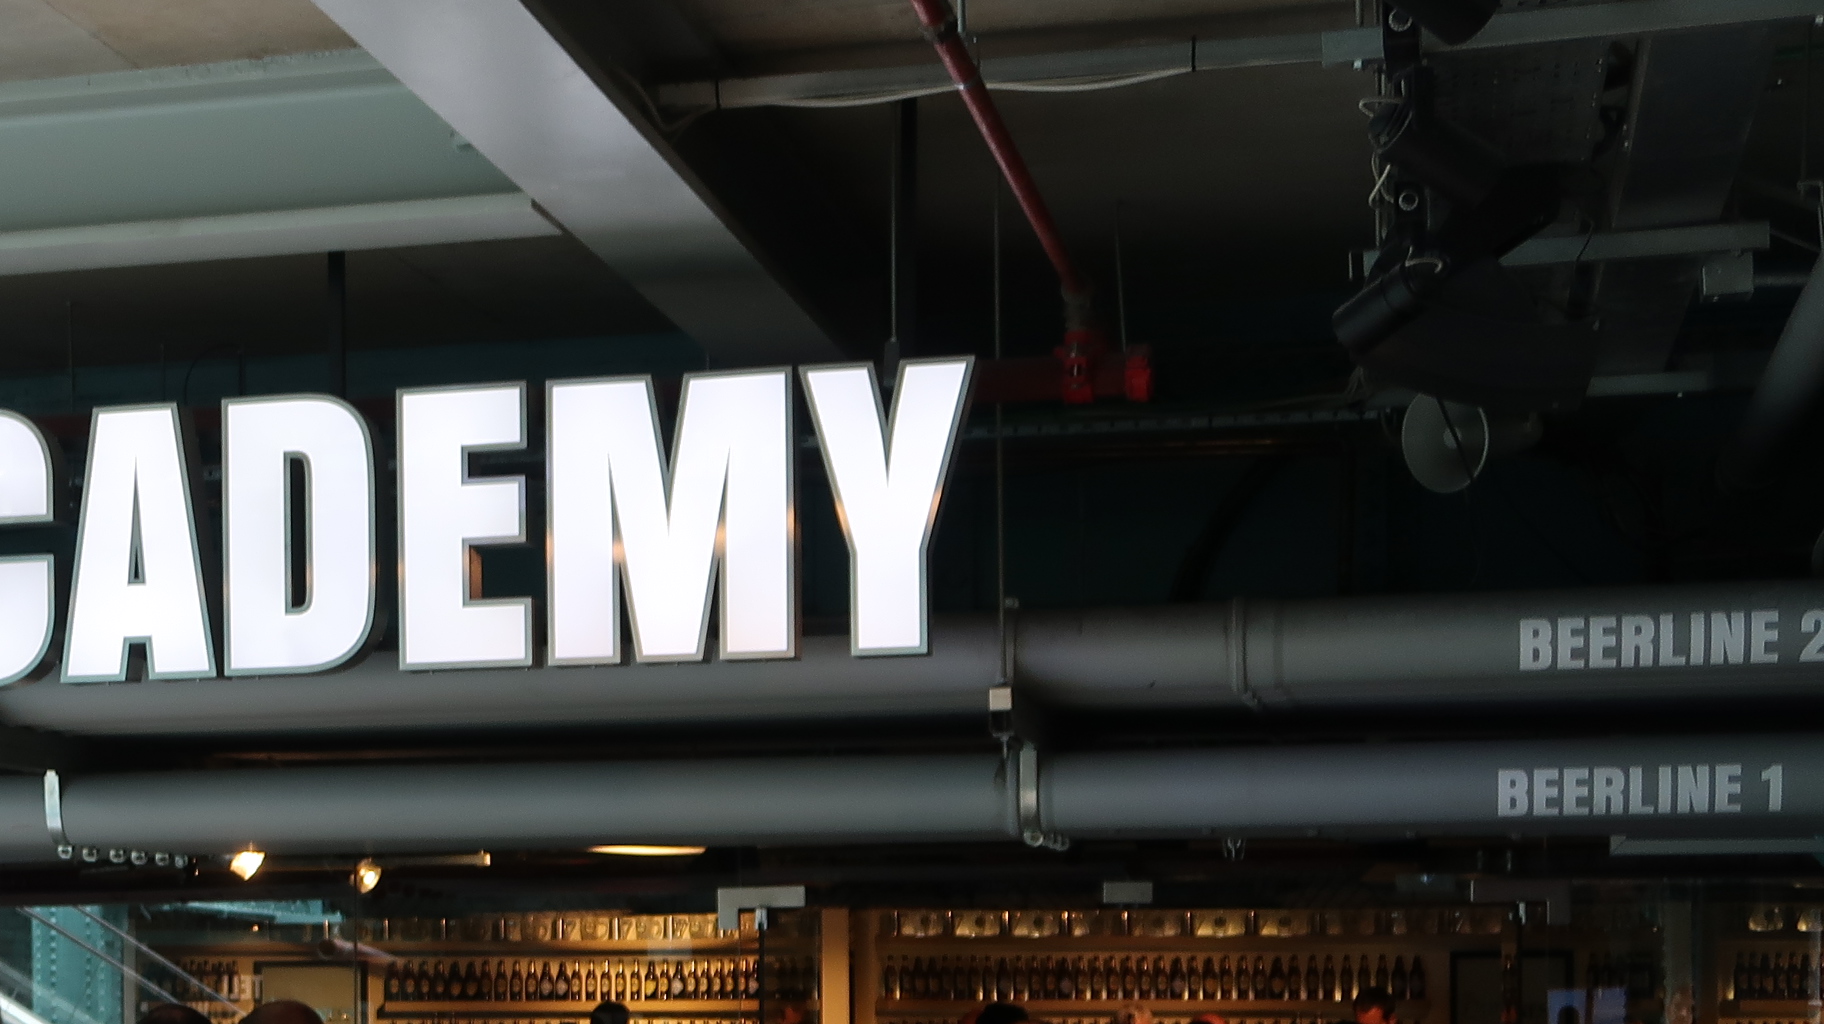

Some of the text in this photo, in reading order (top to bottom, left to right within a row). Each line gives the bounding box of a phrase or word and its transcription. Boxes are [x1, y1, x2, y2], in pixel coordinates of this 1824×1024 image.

[1518, 609, 1824, 671] BEERLINE 2
[1497, 762, 1784, 817] BEERLINE 1
